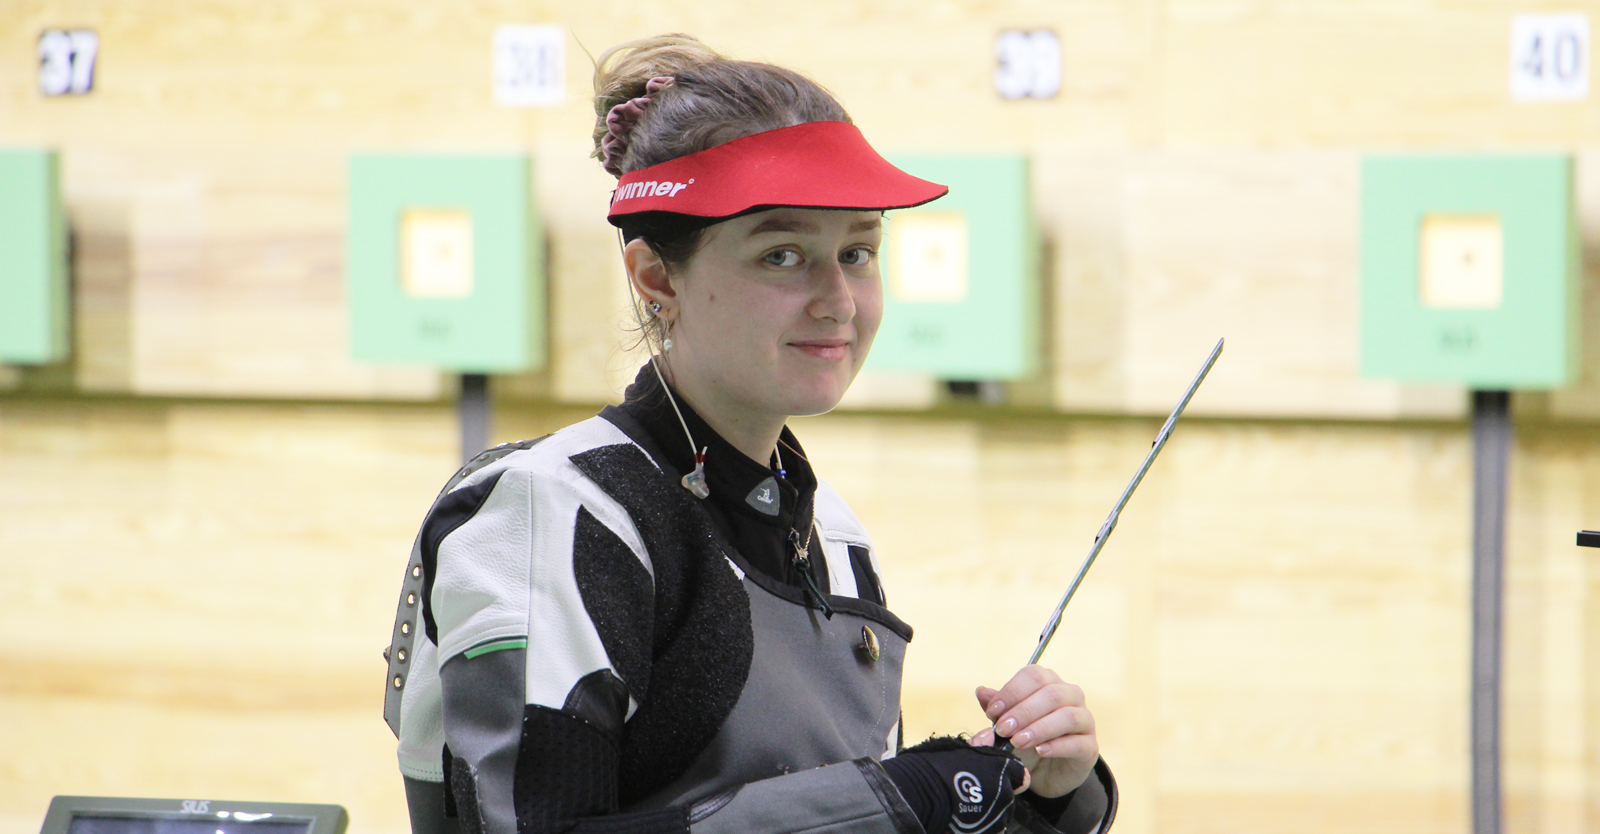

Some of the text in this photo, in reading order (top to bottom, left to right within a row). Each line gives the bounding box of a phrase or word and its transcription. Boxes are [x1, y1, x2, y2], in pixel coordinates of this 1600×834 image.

[38, 29, 98, 97] 37
[507, 42, 560, 88] 38
[993, 30, 1063, 99] 39
[1521, 29, 1583, 84] 40
[958, 802, 983, 813] Sauer
